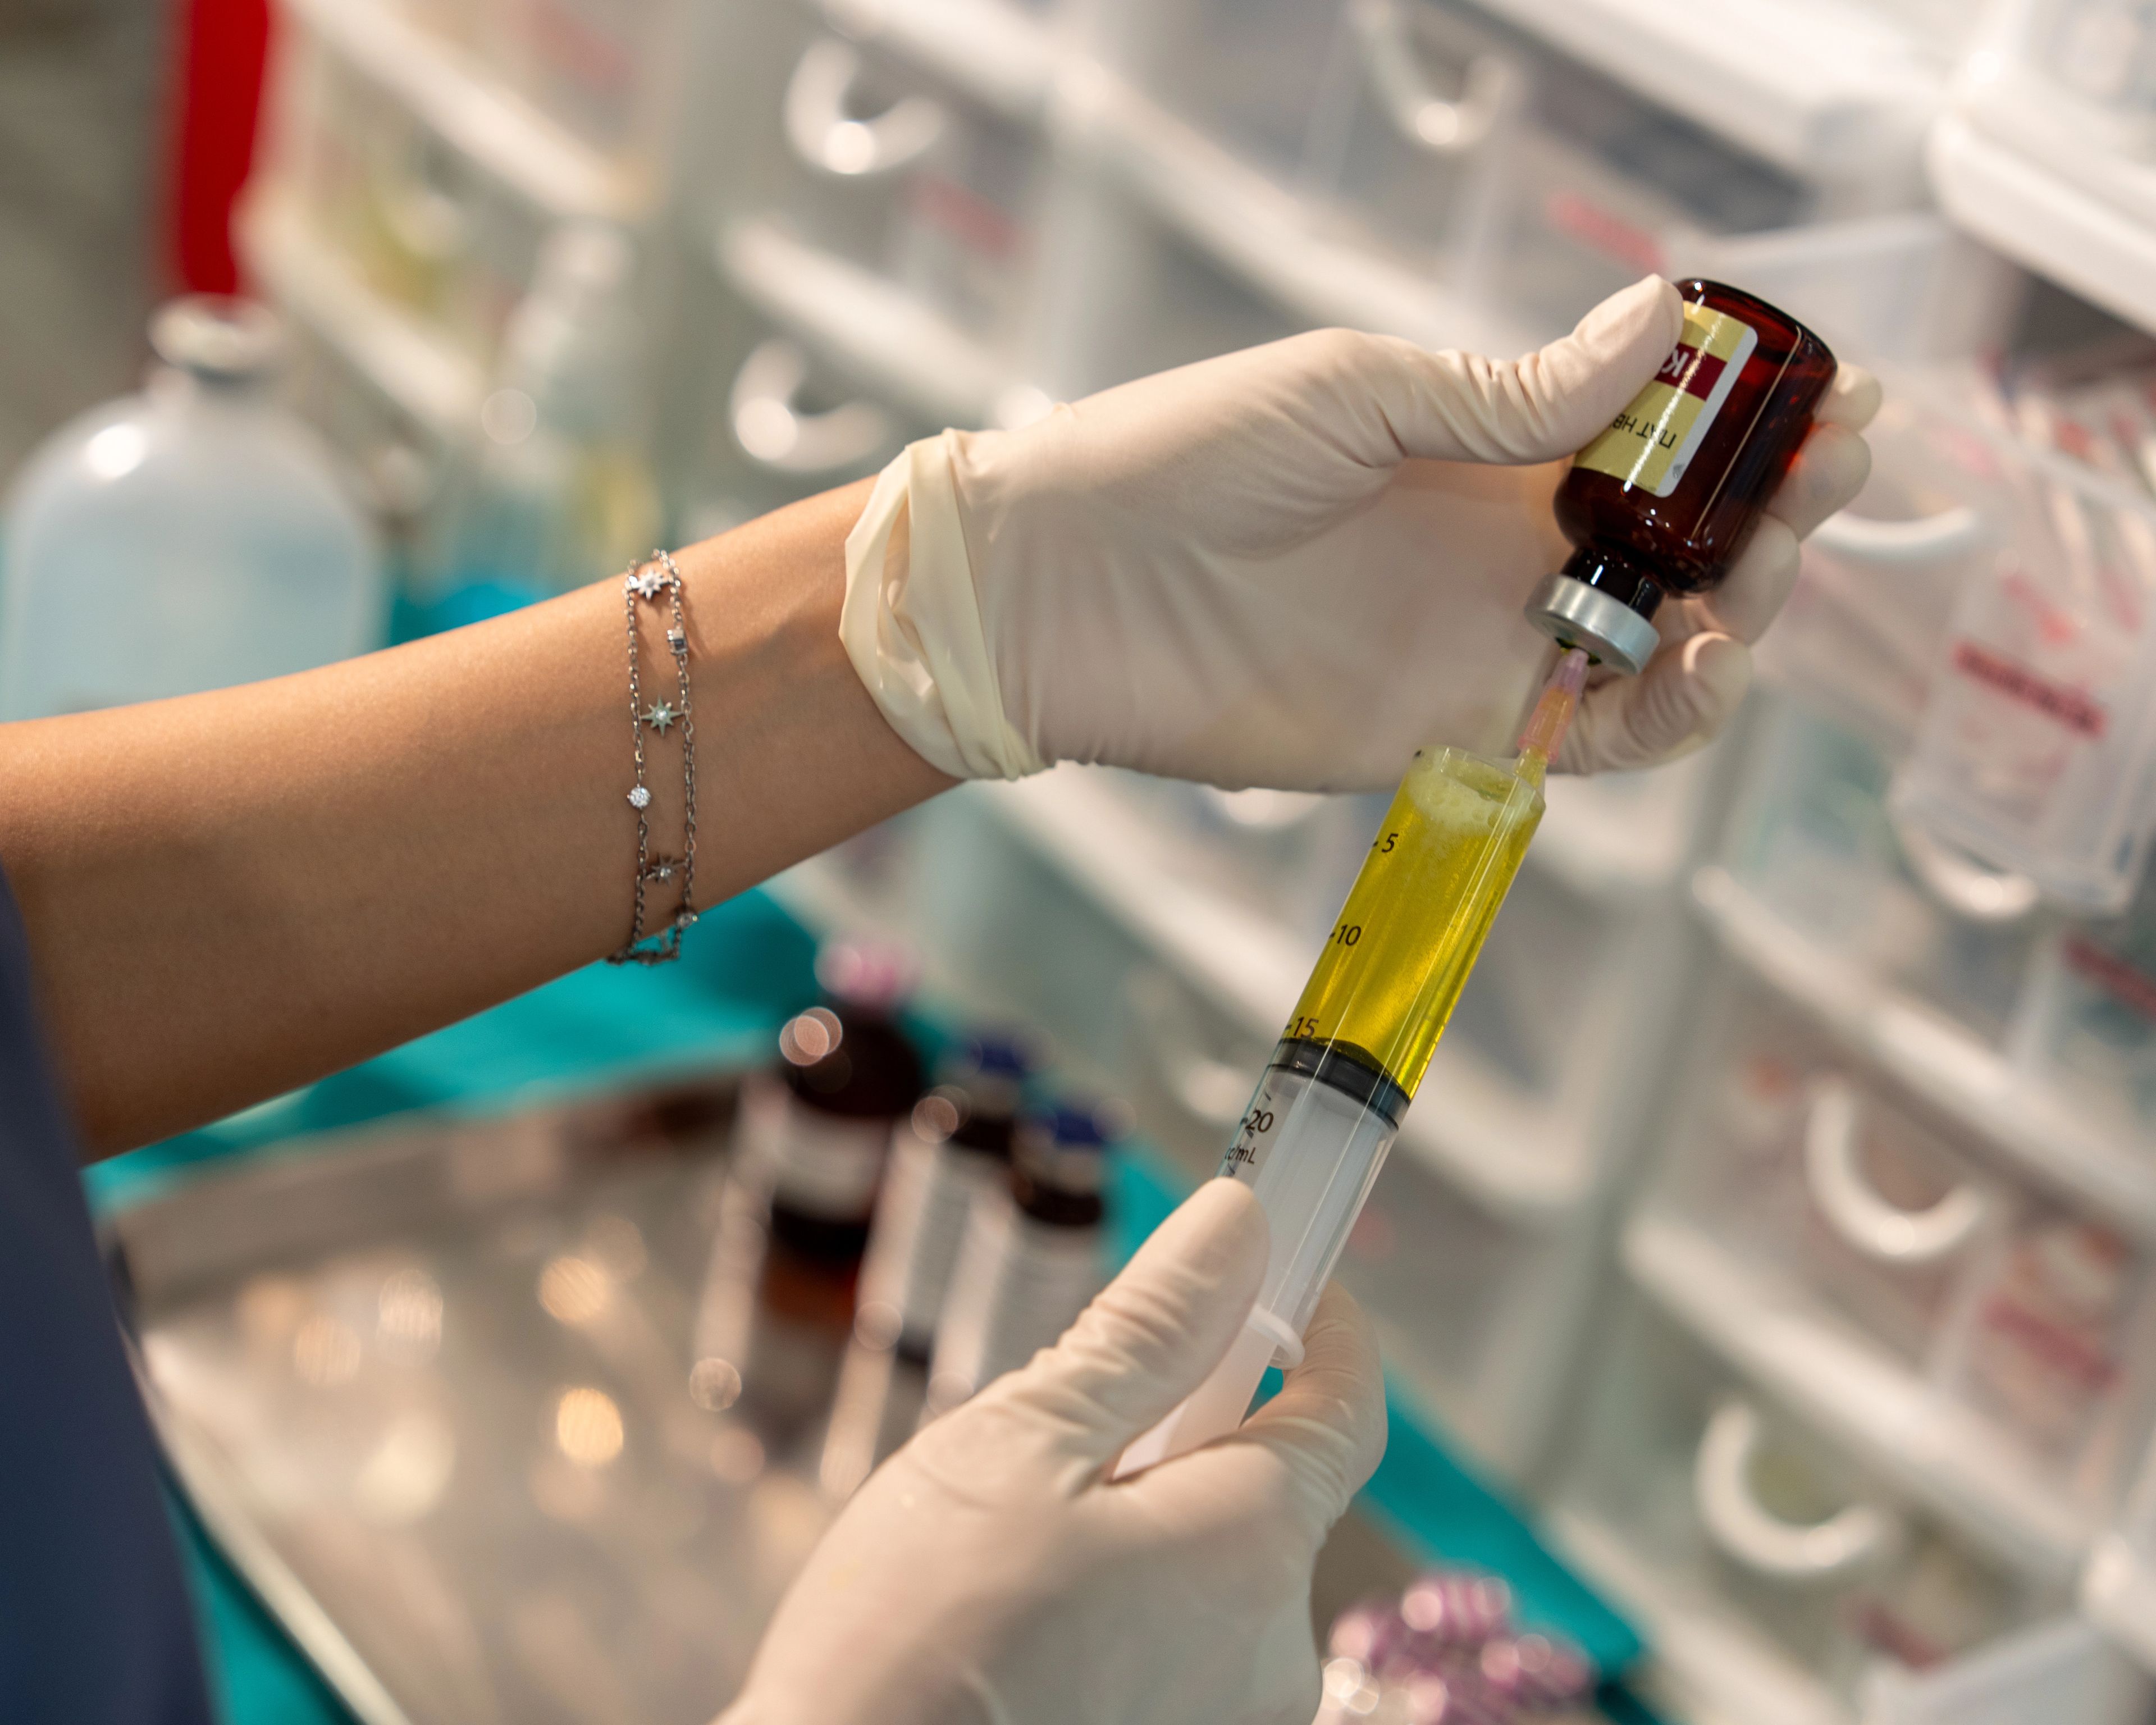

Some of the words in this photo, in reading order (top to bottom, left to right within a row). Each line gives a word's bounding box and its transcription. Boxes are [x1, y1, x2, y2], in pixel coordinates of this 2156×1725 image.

[1613, 413, 1637, 432] НВ
[1381, 832, 1399, 853] 5
[1336, 924, 1361, 947] 10
[1293, 1016, 1319, 1039] 15
[1245, 1109, 1274, 1133] 20
